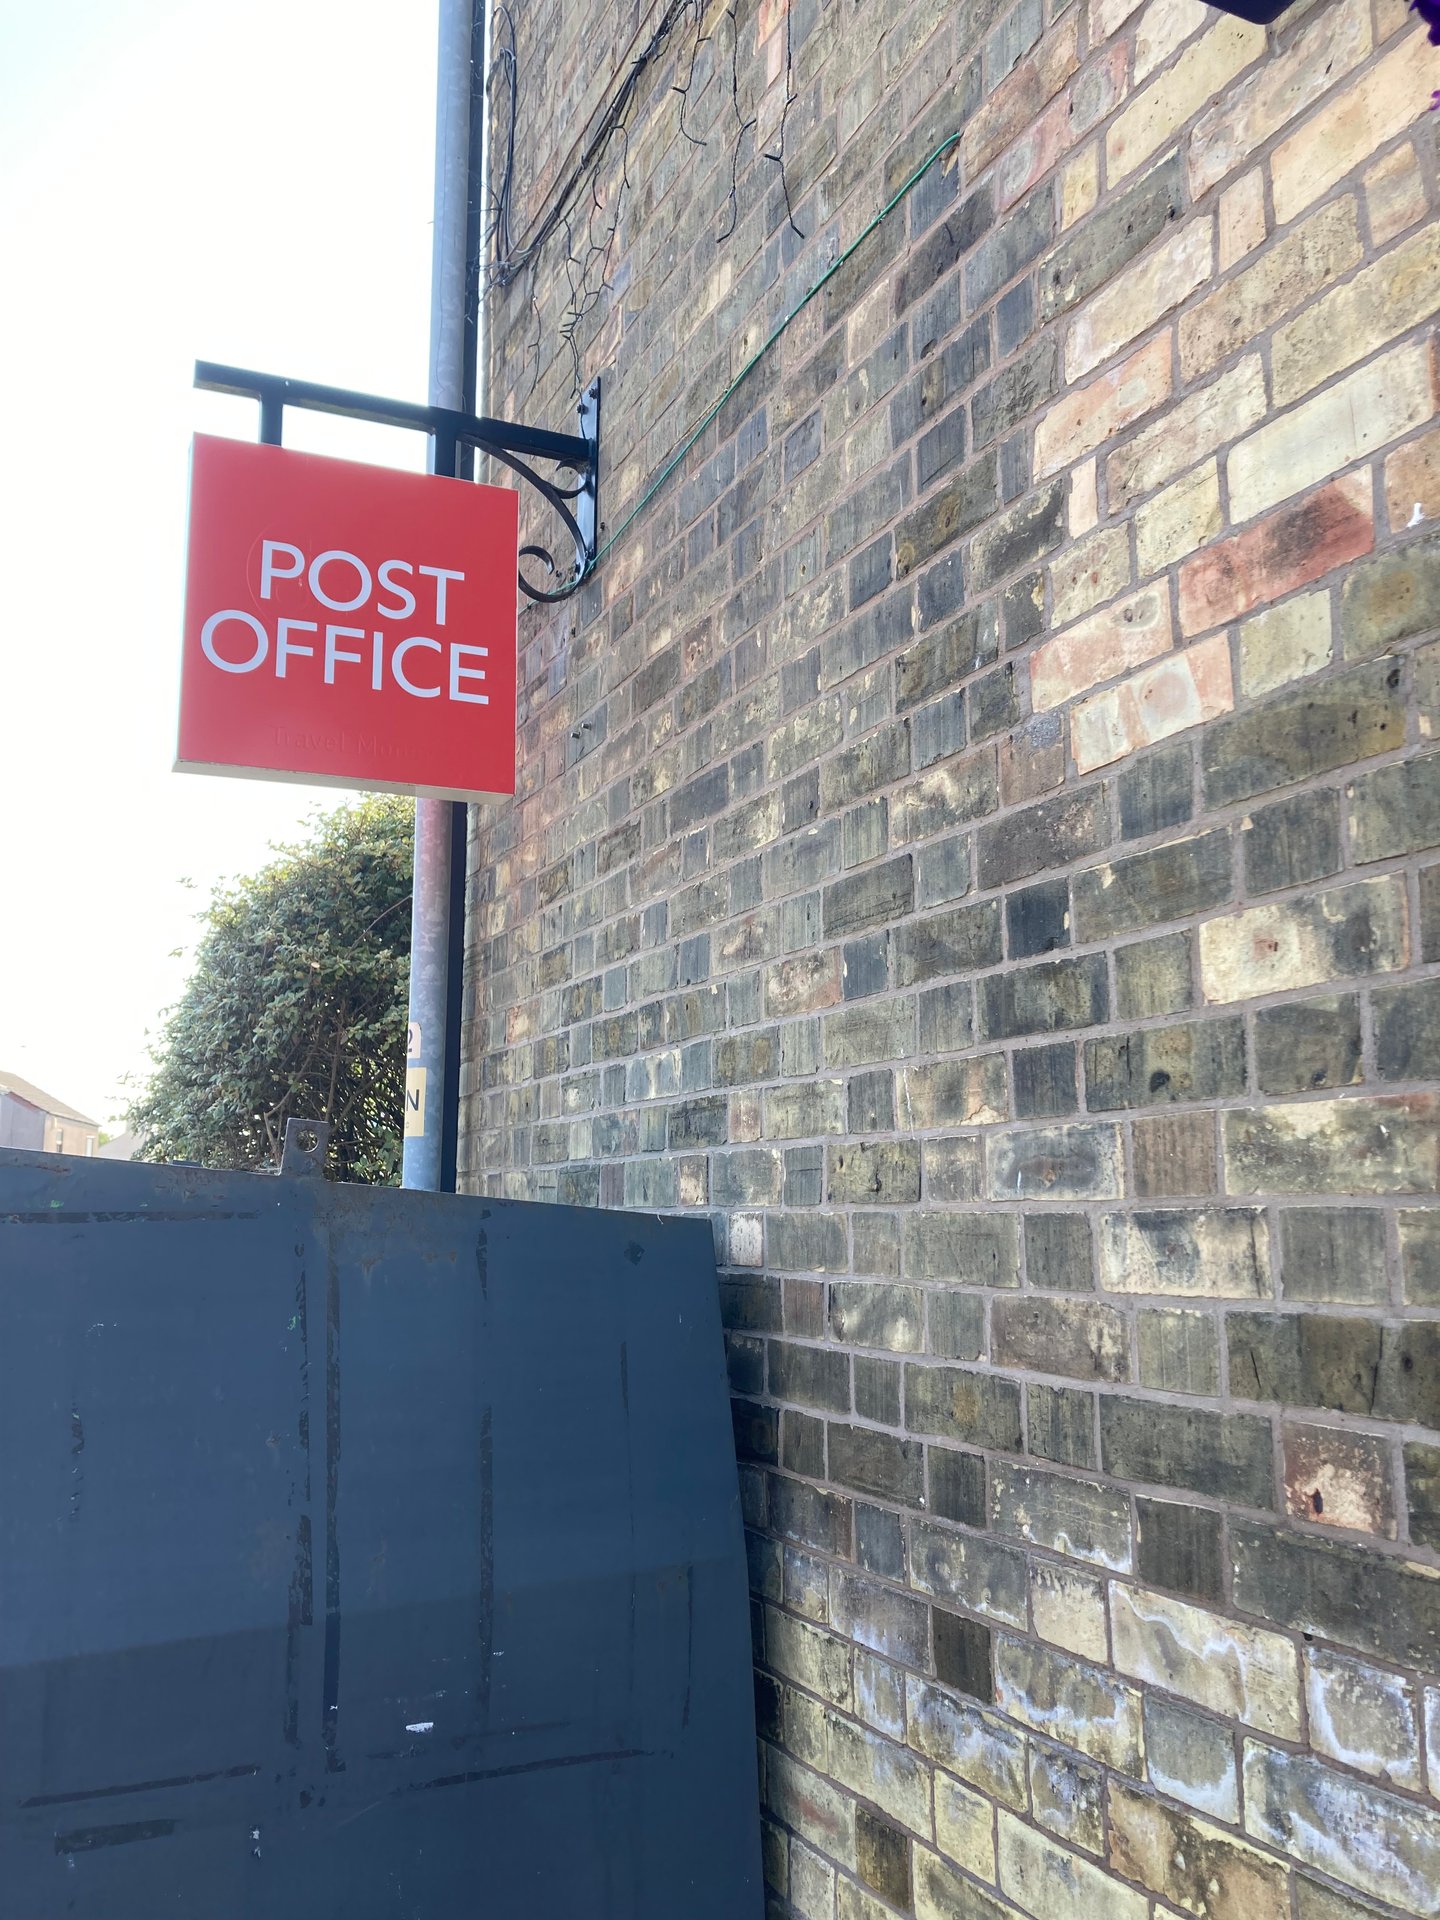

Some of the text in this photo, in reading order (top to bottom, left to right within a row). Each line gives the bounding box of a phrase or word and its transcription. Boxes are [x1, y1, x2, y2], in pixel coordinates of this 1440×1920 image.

[259, 539, 465, 626] POST
[200, 609, 489, 705] OFFICE
[268, 724, 435, 763] Travel Mon
